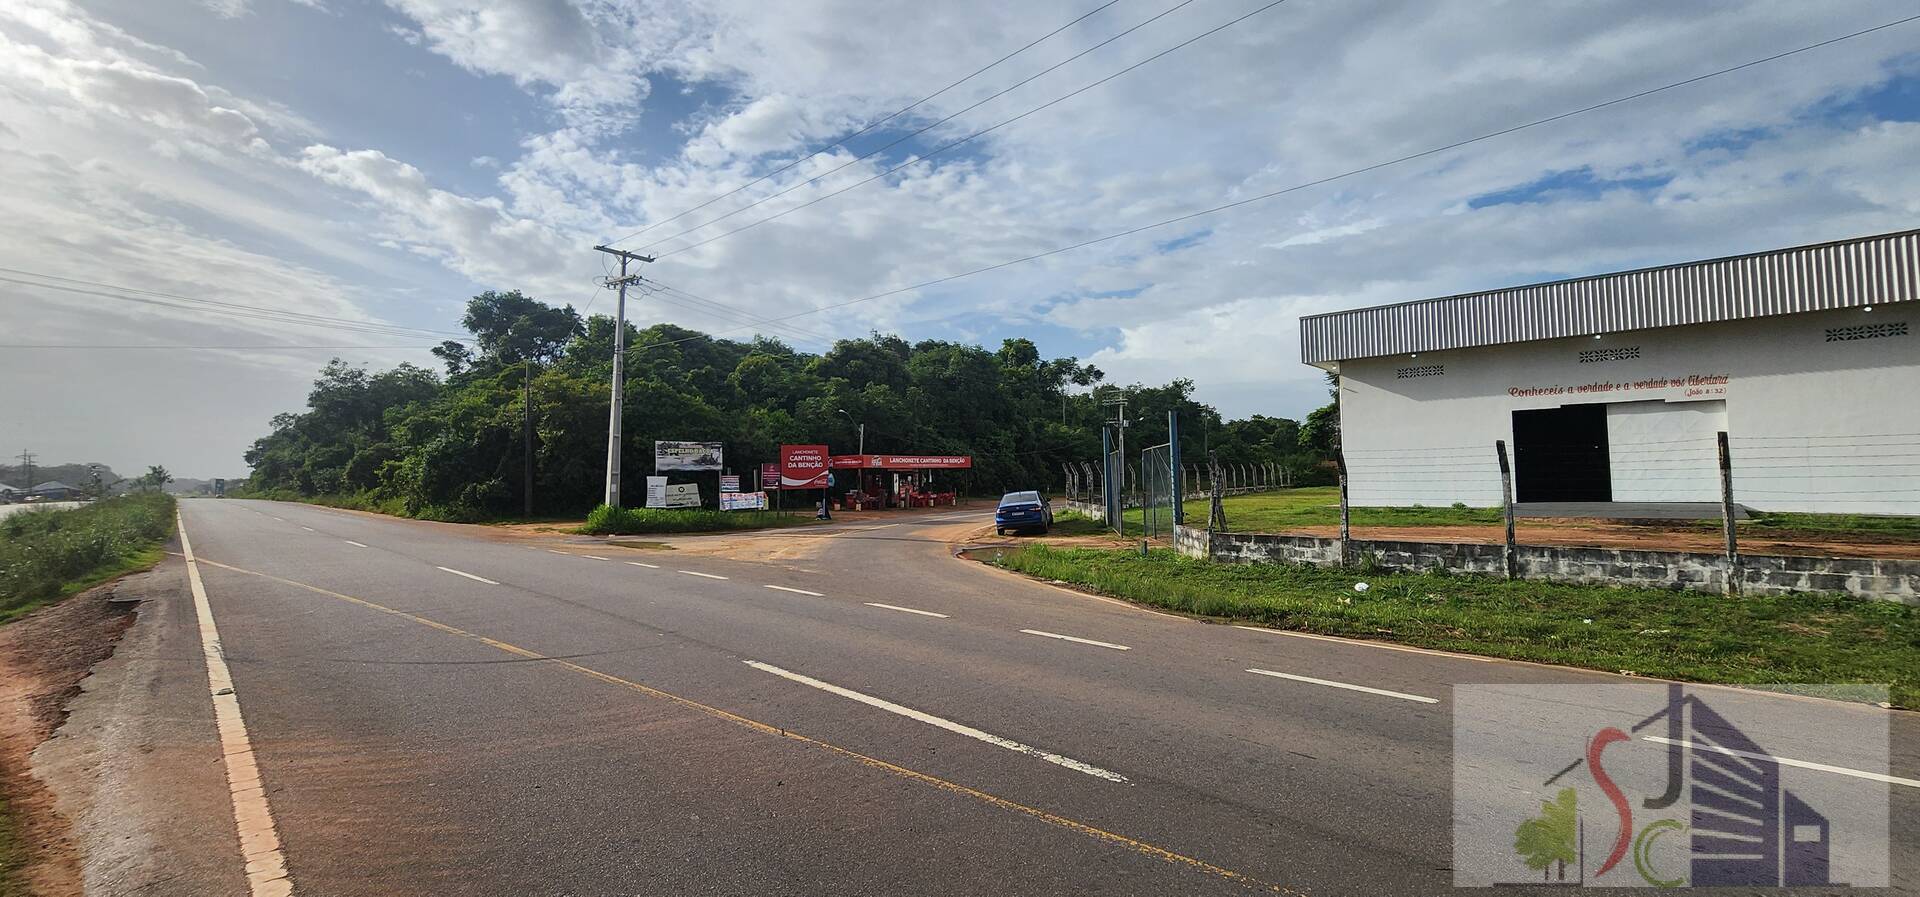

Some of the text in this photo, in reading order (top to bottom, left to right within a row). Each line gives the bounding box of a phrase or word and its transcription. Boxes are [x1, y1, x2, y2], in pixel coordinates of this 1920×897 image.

[1508, 383, 1564, 397] Conheceis
[1567, 386, 1574, 394] a
[1575, 380, 1613, 393] verdade
[1615, 383, 1621, 391] e
[1623, 382, 1630, 391] a
[1633, 377, 1668, 390] verdade
[798, 460, 824, 469] BENÇÃO
